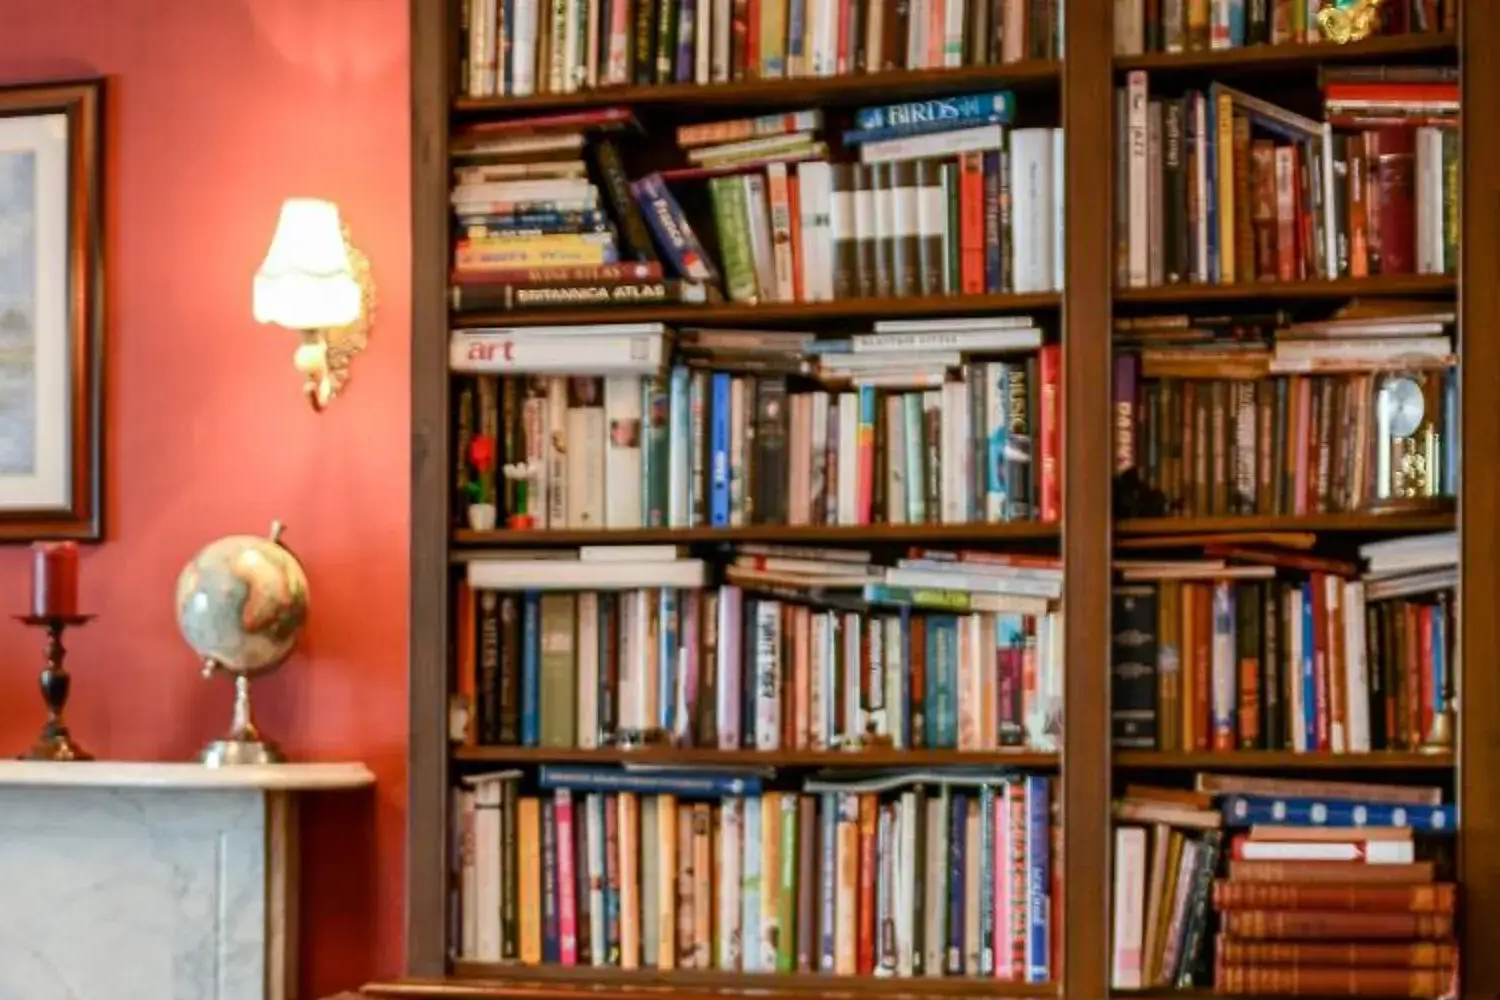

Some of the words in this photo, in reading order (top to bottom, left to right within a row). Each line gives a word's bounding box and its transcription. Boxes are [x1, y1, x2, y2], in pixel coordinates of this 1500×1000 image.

[887, 99, 960, 125] BIRDS
[517, 287, 609, 303] BRITANNICA
[613, 284, 666, 299] ATLAS
[467, 338, 516, 362] art
[1009, 371, 1027, 432] MUSIC
